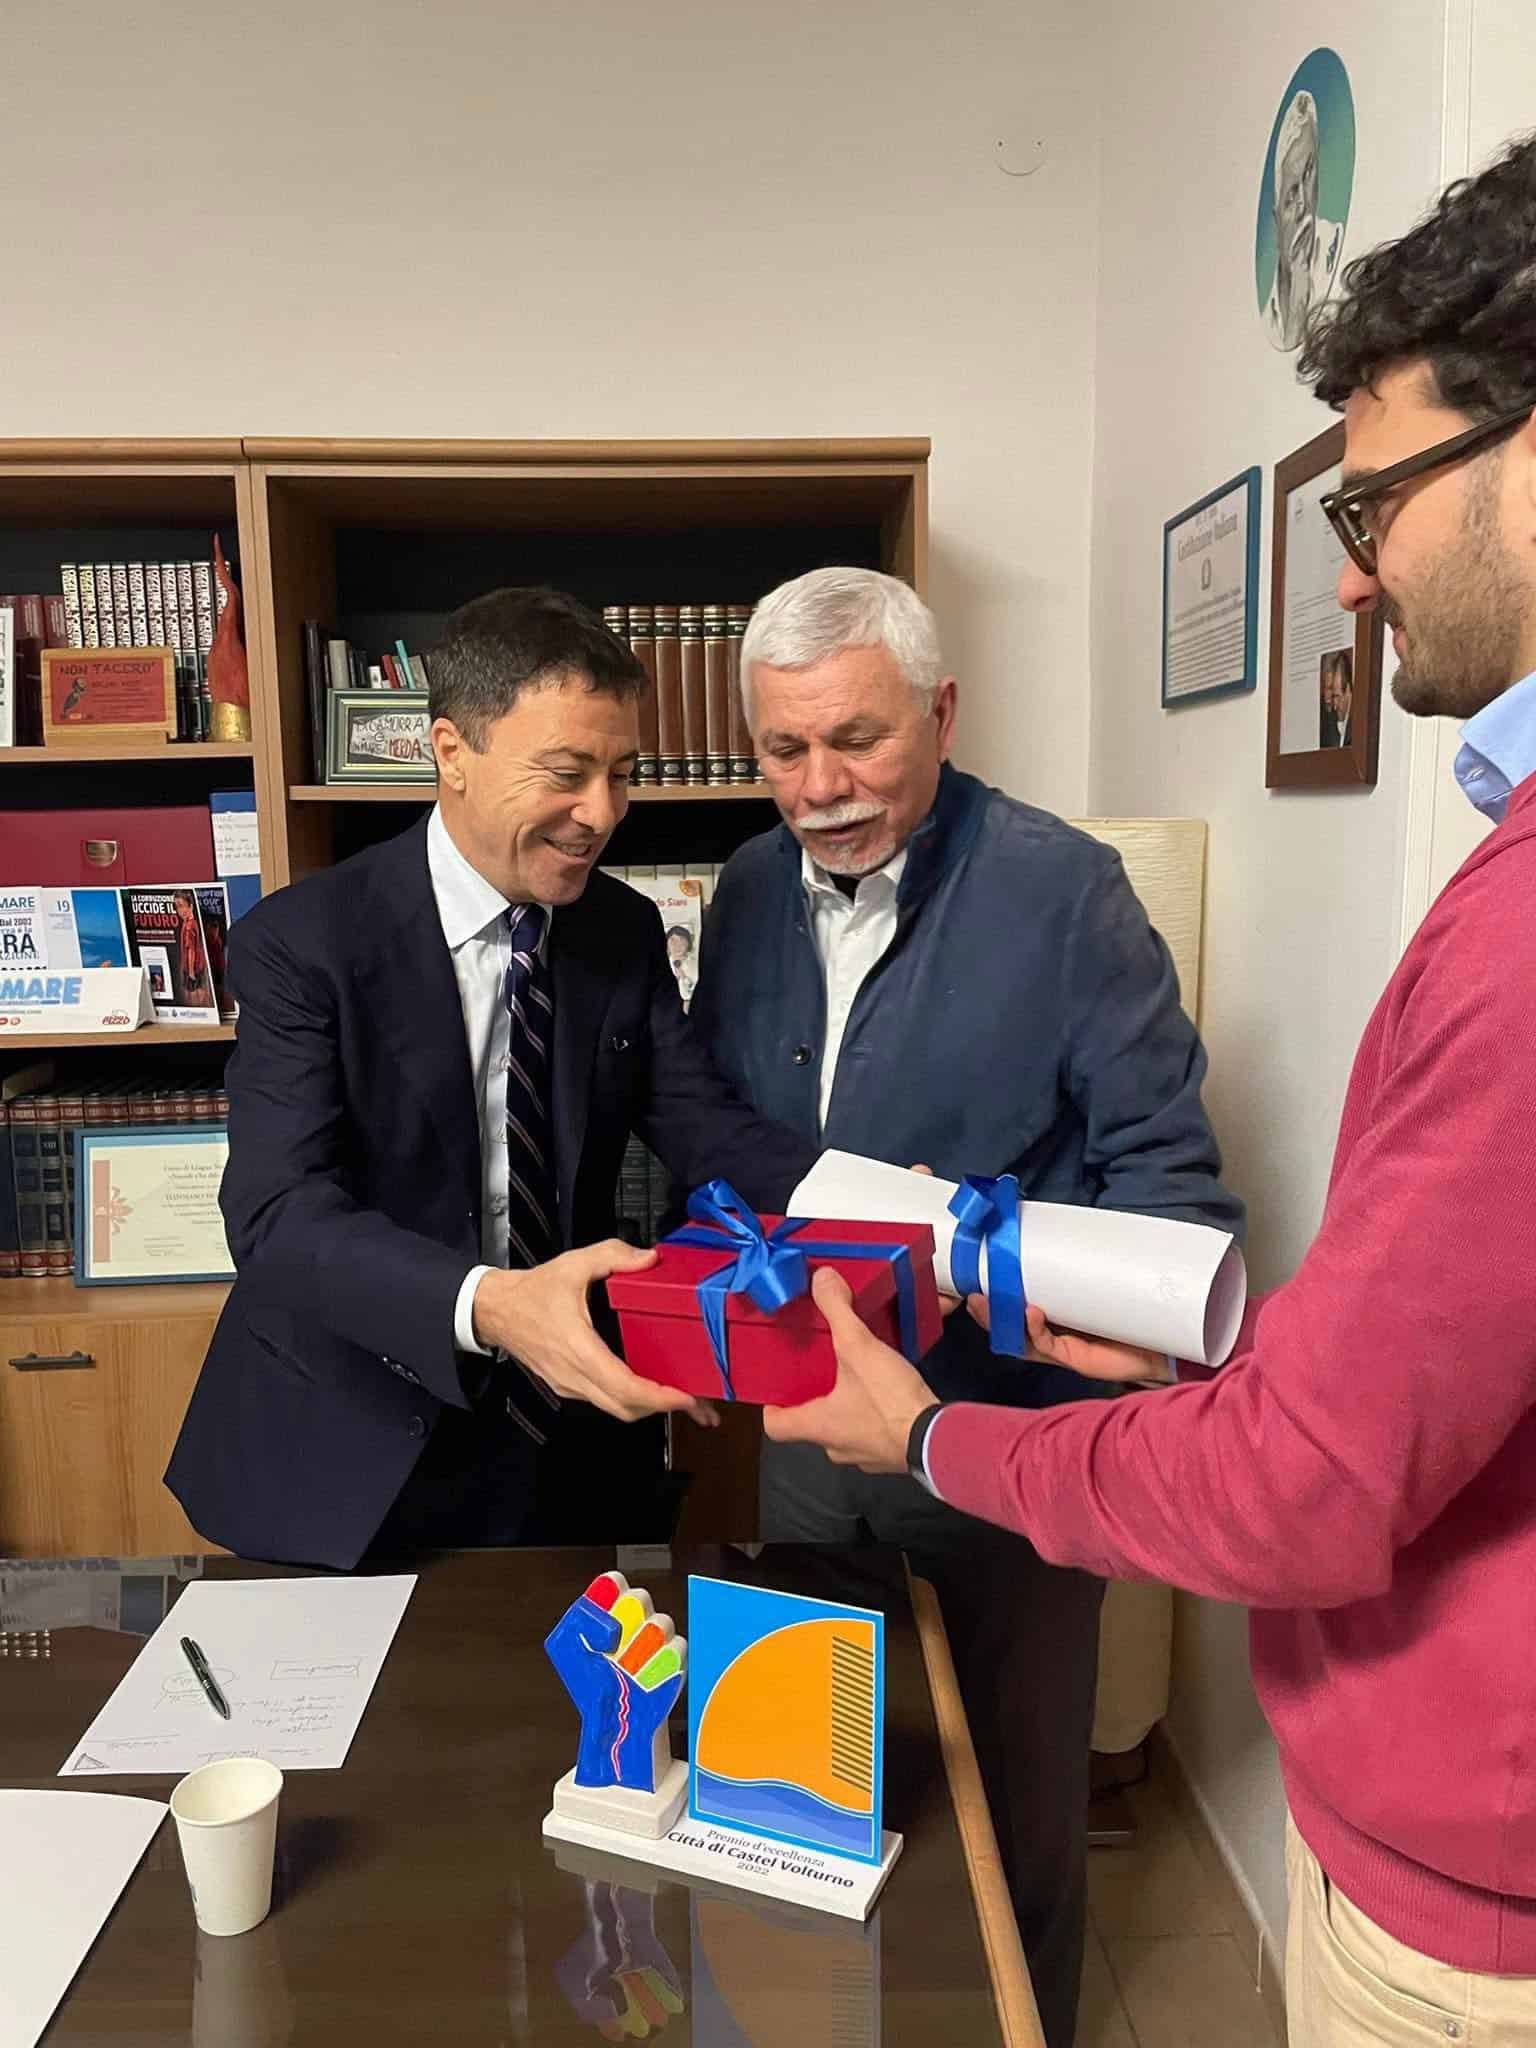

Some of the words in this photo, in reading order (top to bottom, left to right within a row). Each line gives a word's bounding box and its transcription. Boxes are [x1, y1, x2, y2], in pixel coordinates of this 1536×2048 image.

[132, 902, 165, 914] UCCIDE
[166, 902, 177, 914] IL
[135, 914, 180, 927] FUTURO
[707, 1829, 750, 1848] Premio
[753, 1841, 825, 1868] d'eccellenza
[668, 1831, 705, 1849] Città
[708, 1842, 725, 1854] di
[727, 1847, 777, 1868] Castel
[781, 1861, 855, 1889] Volturno
[736, 1861, 770, 1877] 2022
